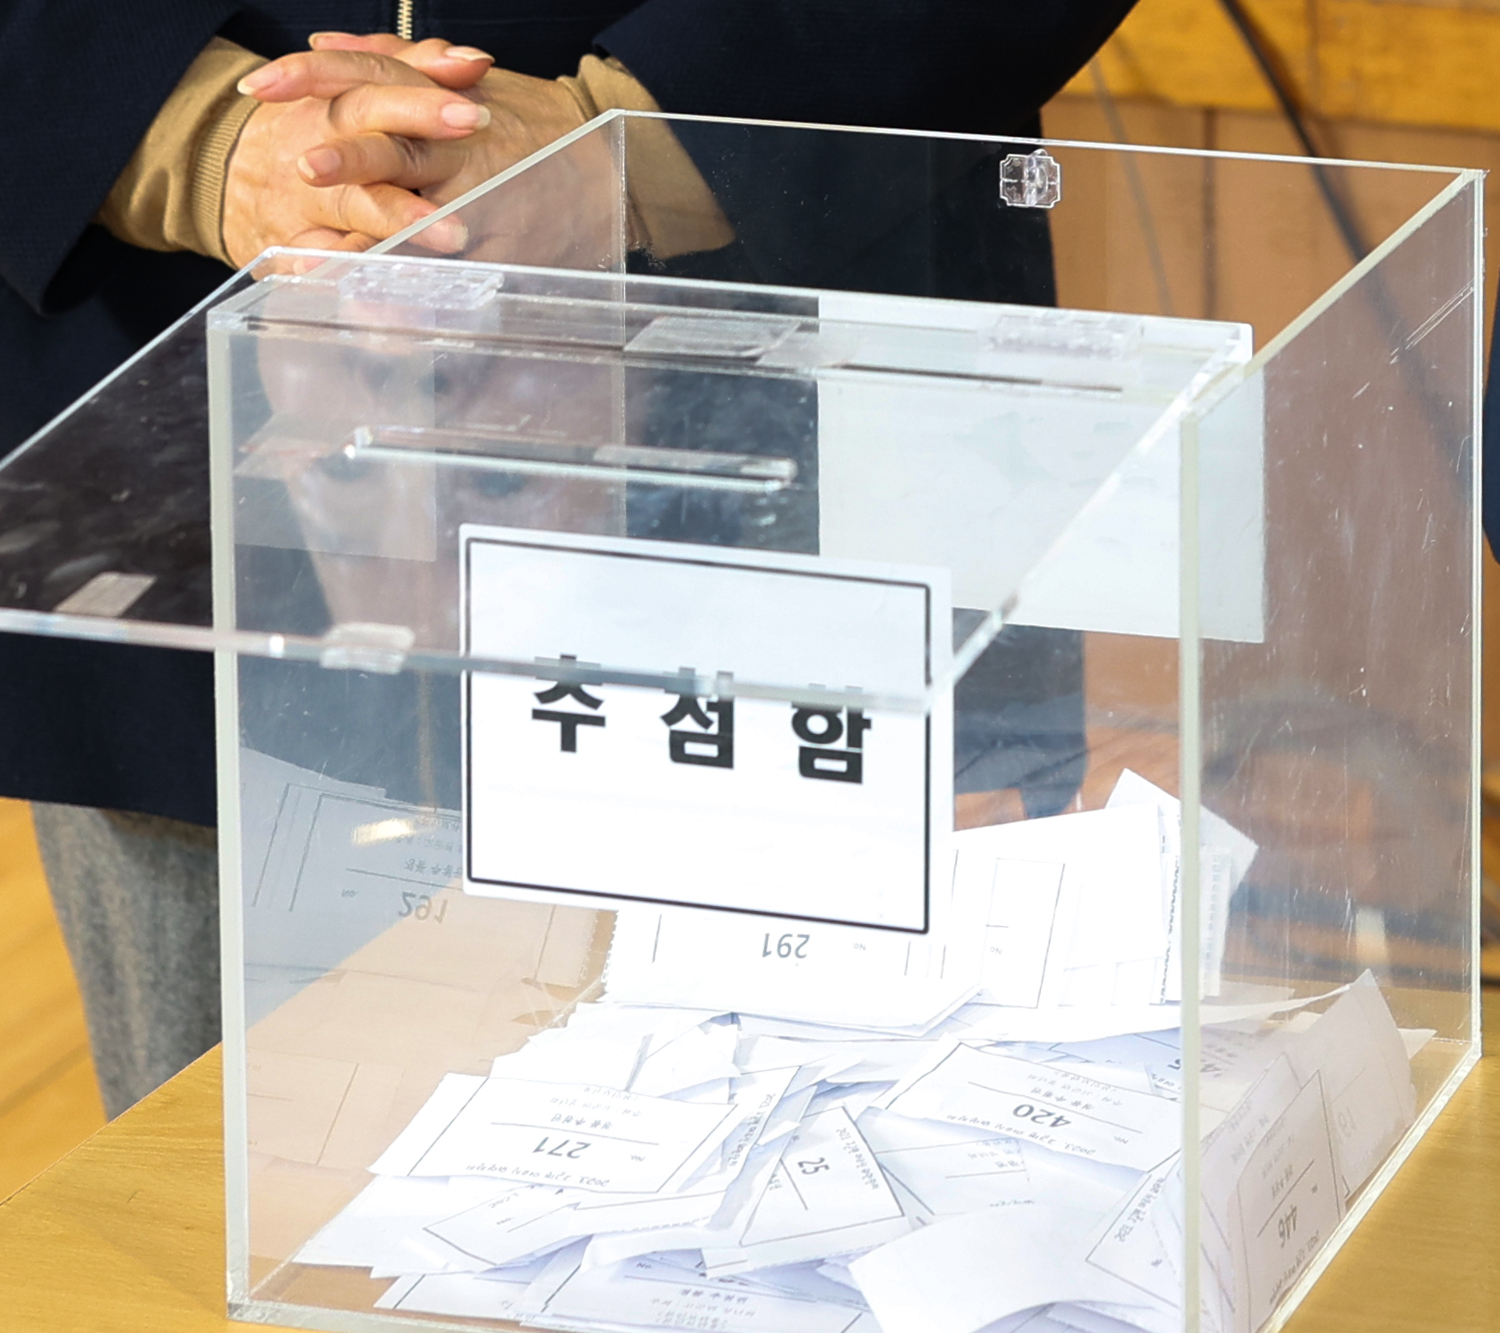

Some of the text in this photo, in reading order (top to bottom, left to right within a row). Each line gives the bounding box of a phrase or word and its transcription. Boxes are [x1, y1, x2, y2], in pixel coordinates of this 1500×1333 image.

[761, 932, 811, 959] 291
[1012, 1103, 1072, 1128] 420
[532, 1136, 592, 1159] 271
[797, 1156, 831, 1175] 25
[1277, 1202, 1298, 1249] 446
